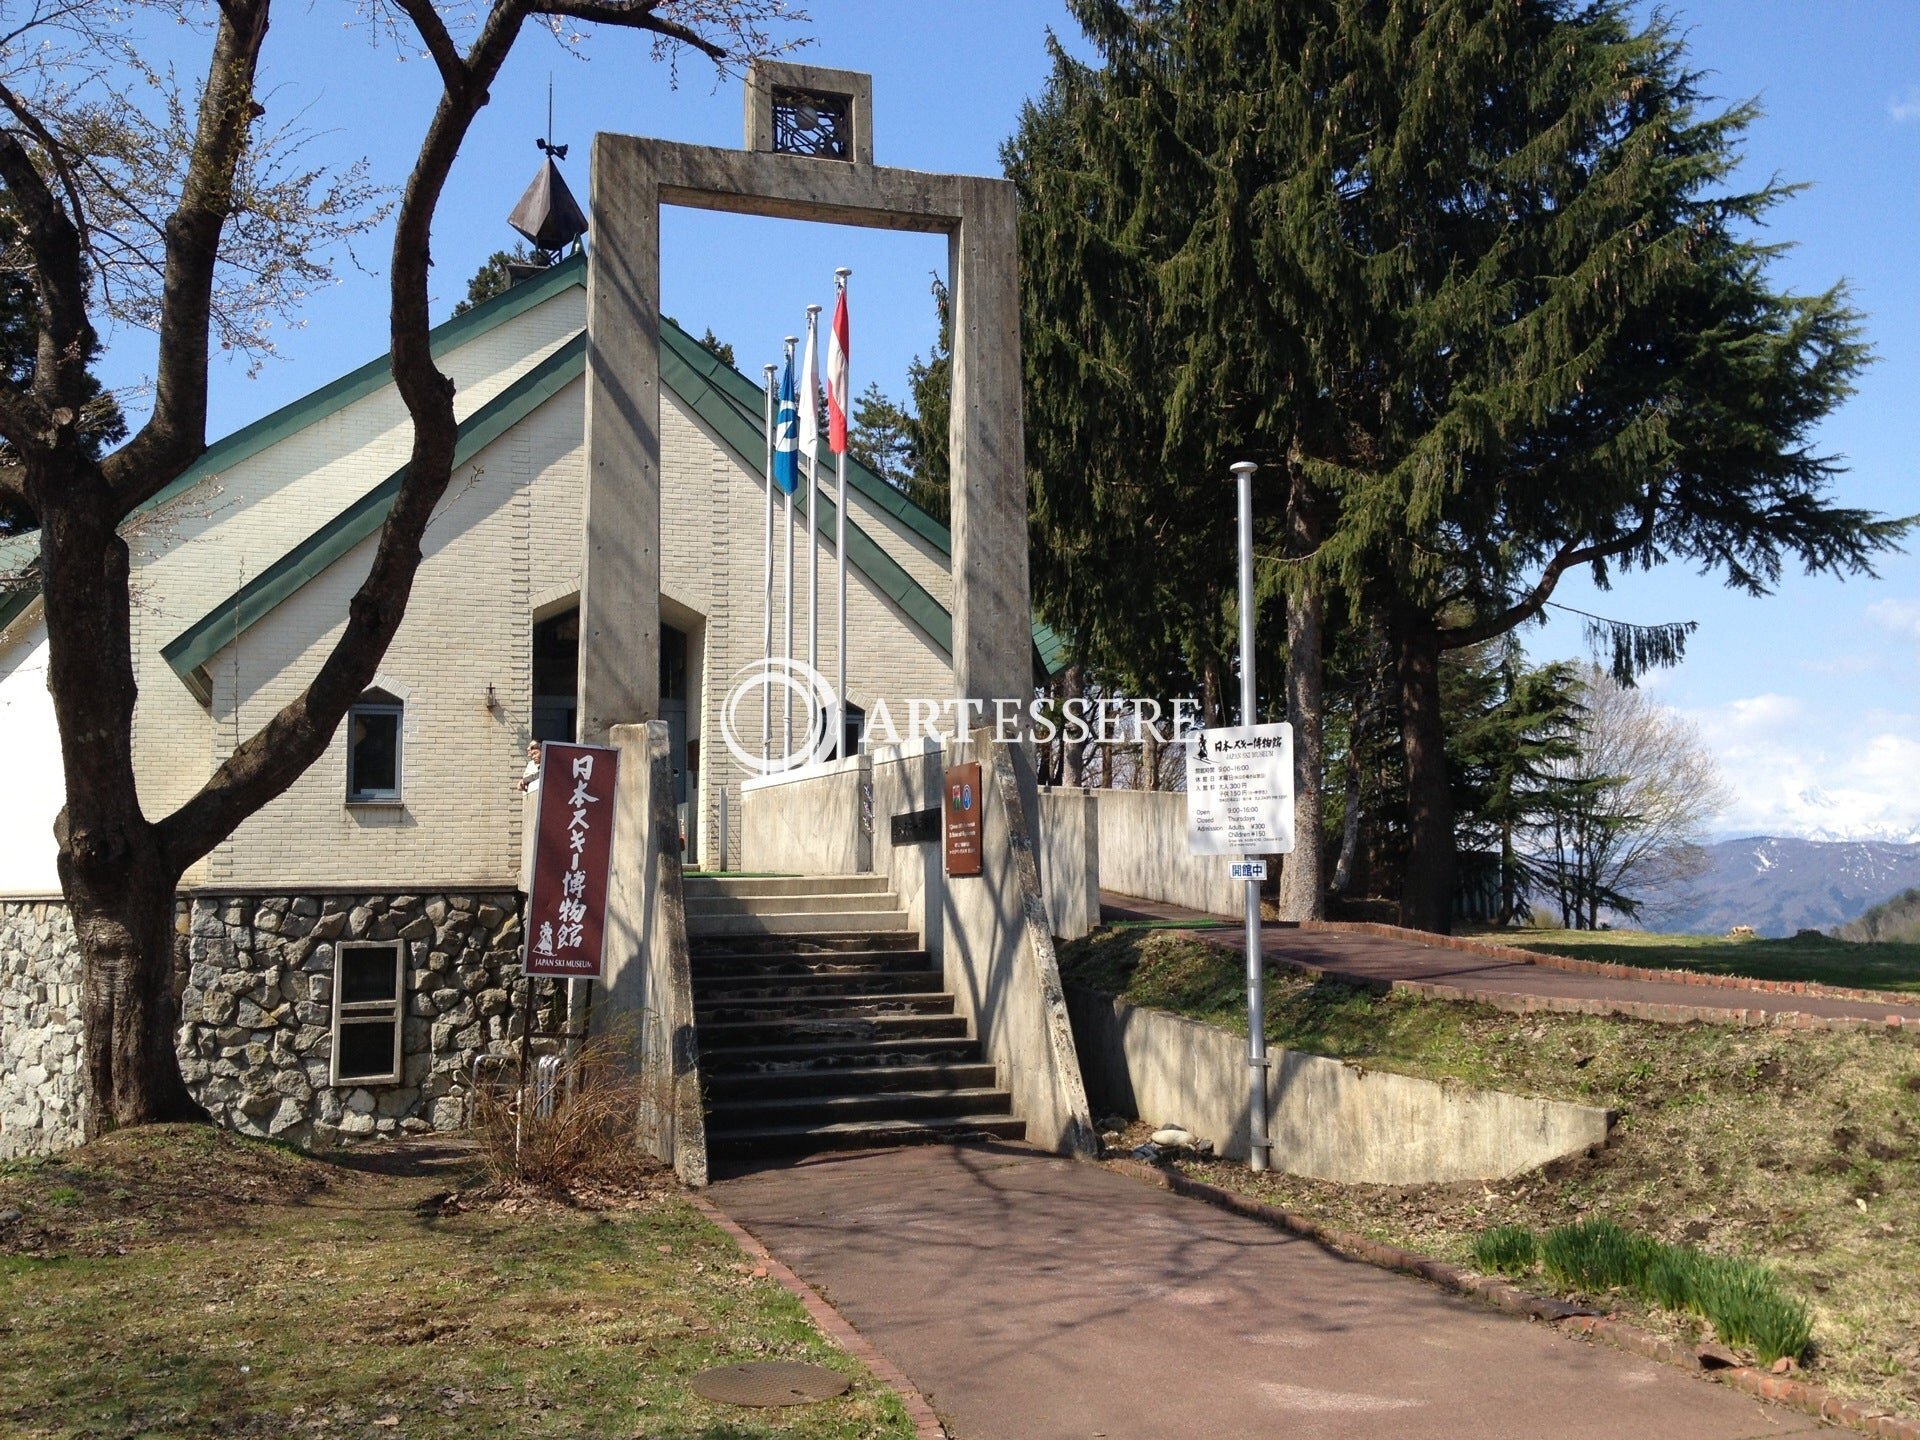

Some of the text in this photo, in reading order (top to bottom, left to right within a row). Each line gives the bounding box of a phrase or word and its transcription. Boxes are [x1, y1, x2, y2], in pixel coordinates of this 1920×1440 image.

[1215, 736, 1282, 752] 日本スキー博物館
[556, 754, 600, 950] 日本スキー博物館
[1232, 864, 1263, 877] 開館中
[535, 958, 593, 968] JAPAN SKI MUSEUM
